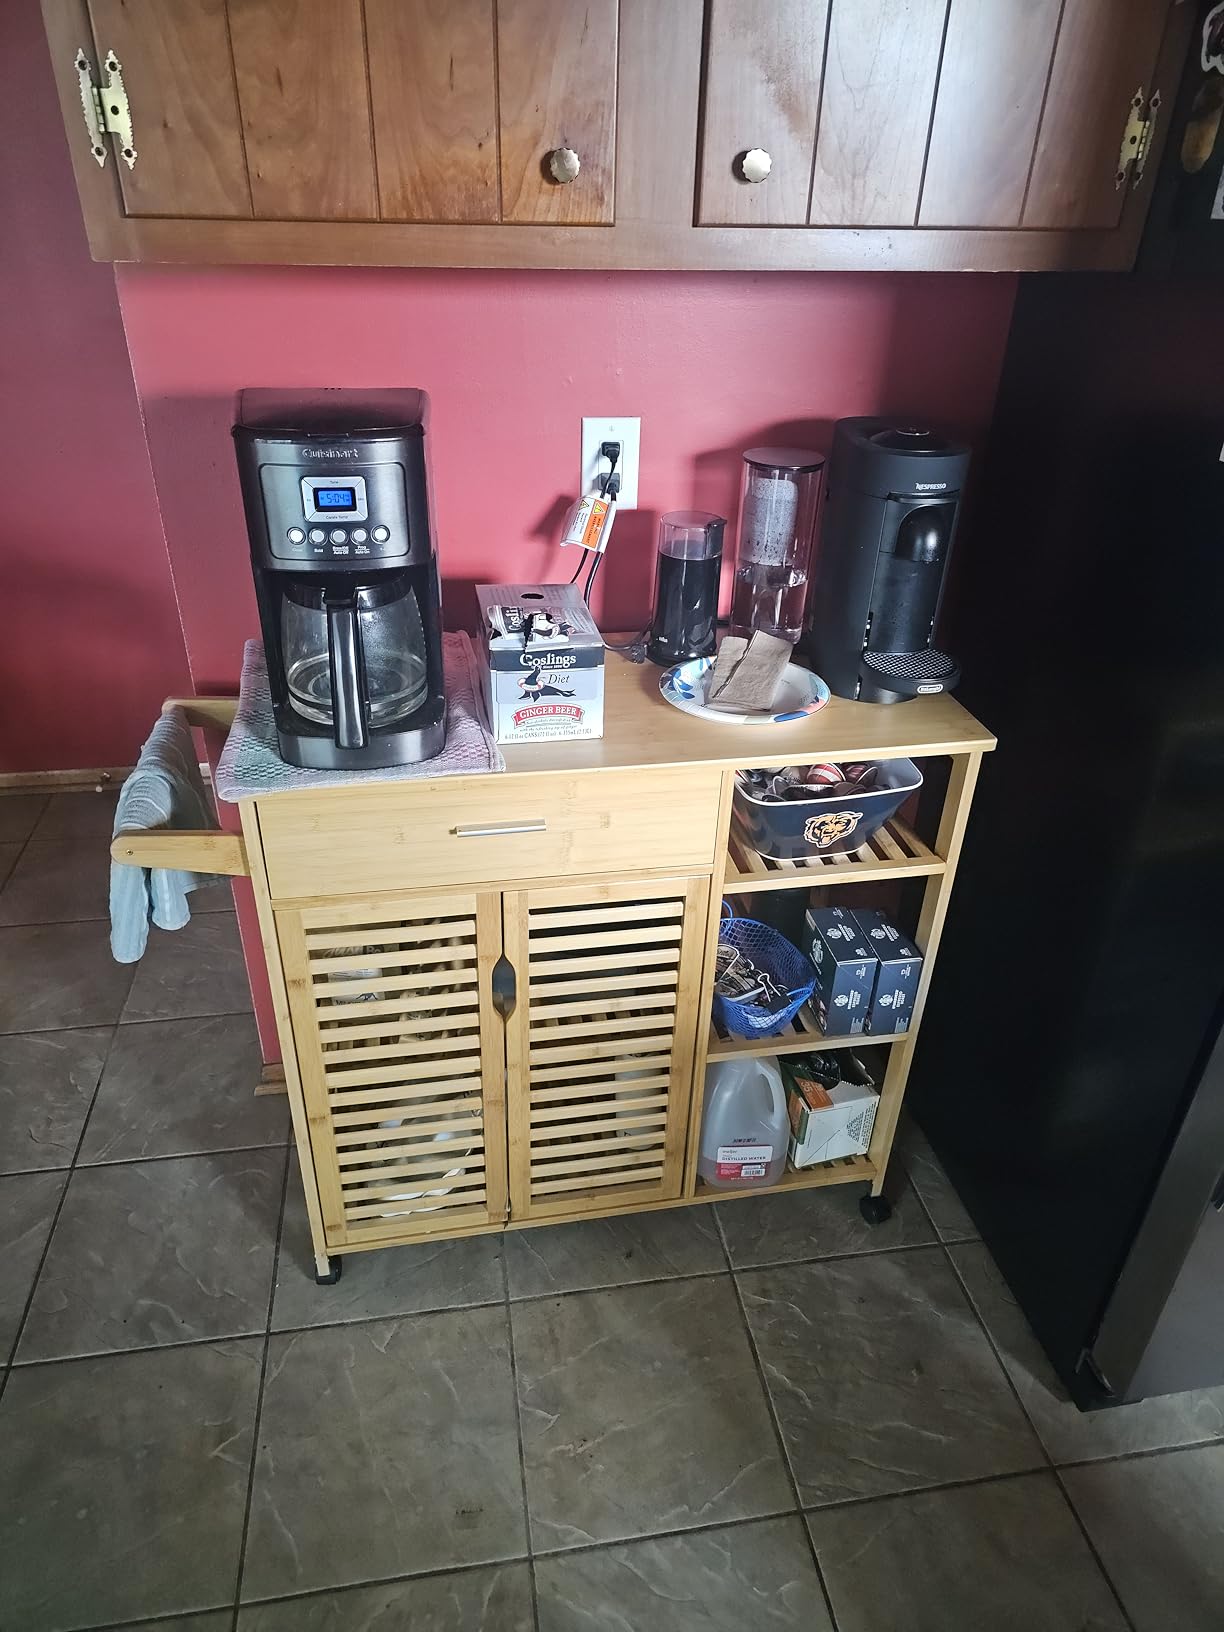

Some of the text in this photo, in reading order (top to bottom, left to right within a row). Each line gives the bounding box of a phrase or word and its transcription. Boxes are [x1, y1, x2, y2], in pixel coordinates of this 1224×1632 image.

[326, 493, 346, 504] 5:04
[519, 653, 577, 669] Goslings
[548, 673, 570, 684] Diet
[519, 706, 577, 720] GINGER BEER
